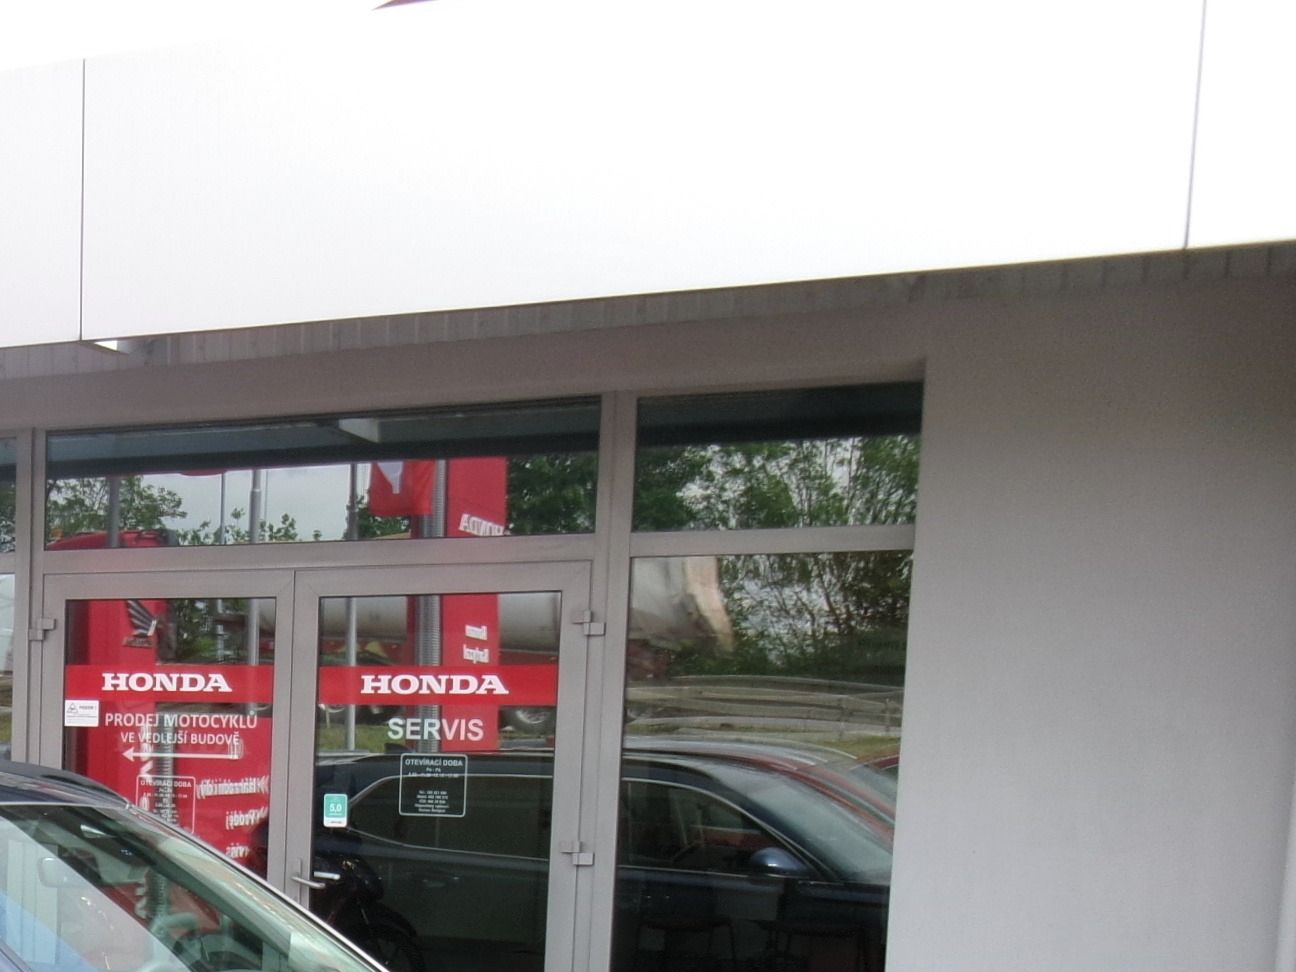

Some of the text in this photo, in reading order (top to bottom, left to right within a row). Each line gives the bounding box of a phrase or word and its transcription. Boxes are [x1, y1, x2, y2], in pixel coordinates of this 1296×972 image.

[102, 672, 233, 693] HONDA
[360, 674, 510, 695] HONDA
[105, 712, 159, 728] PRODEJ
[163, 709, 258, 729] MOTOCYKLŮ
[120, 730, 240, 745] VE VEDLEJŠÍ BUDOVĚ
[387, 717, 484, 742] SERVIS
[442, 759, 463, 767] DOBA
